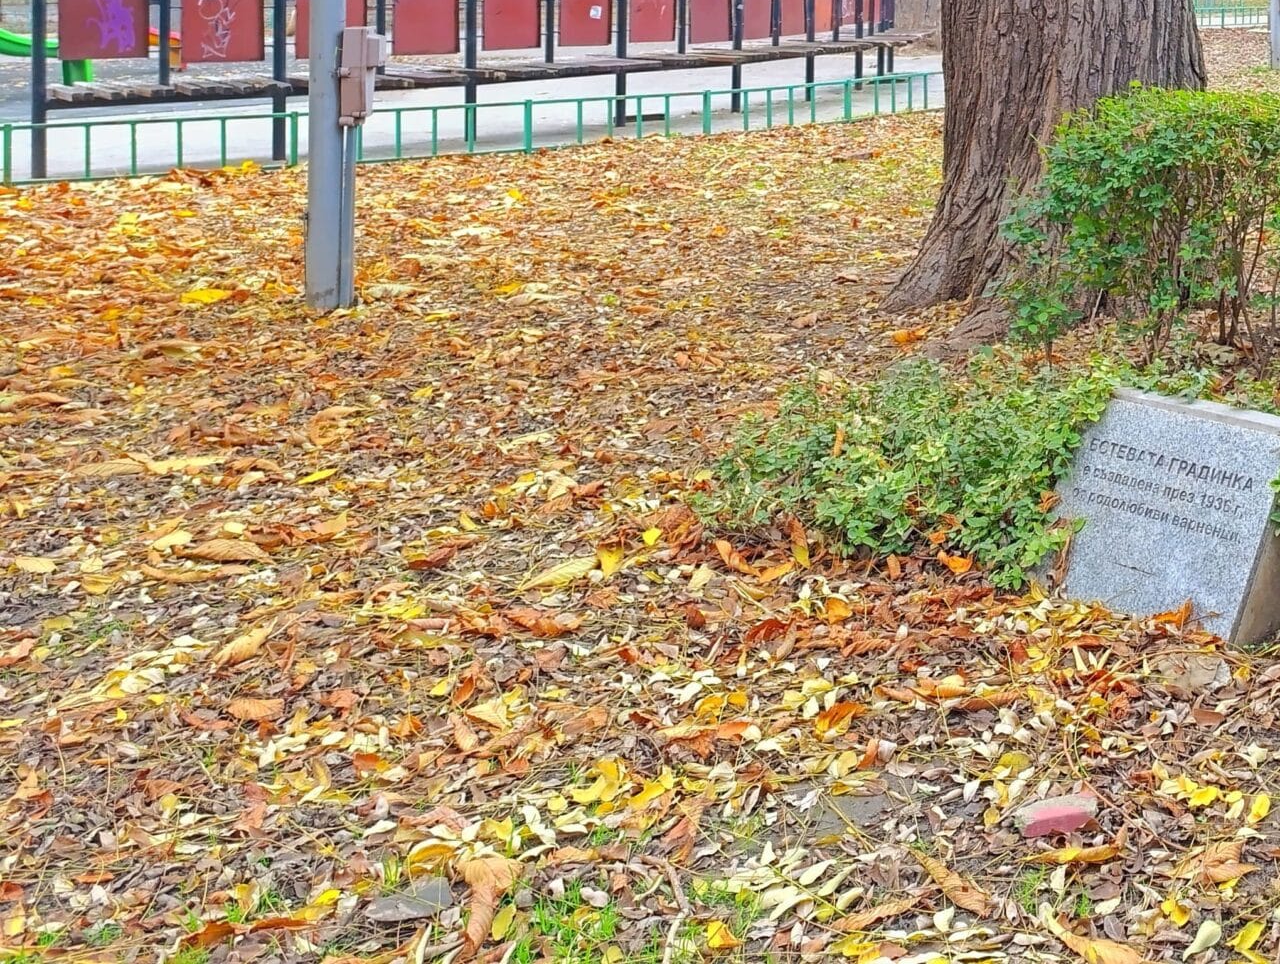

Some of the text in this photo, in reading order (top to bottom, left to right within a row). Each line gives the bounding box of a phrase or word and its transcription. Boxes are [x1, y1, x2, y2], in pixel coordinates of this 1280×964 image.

[1083, 465, 1091, 476] е
[1093, 467, 1160, 494] създадена
[1163, 486, 1196, 504] през
[1167, 457, 1254, 493] ГРАДИНКА
[1087, 492, 1170, 523] родолюбиви
